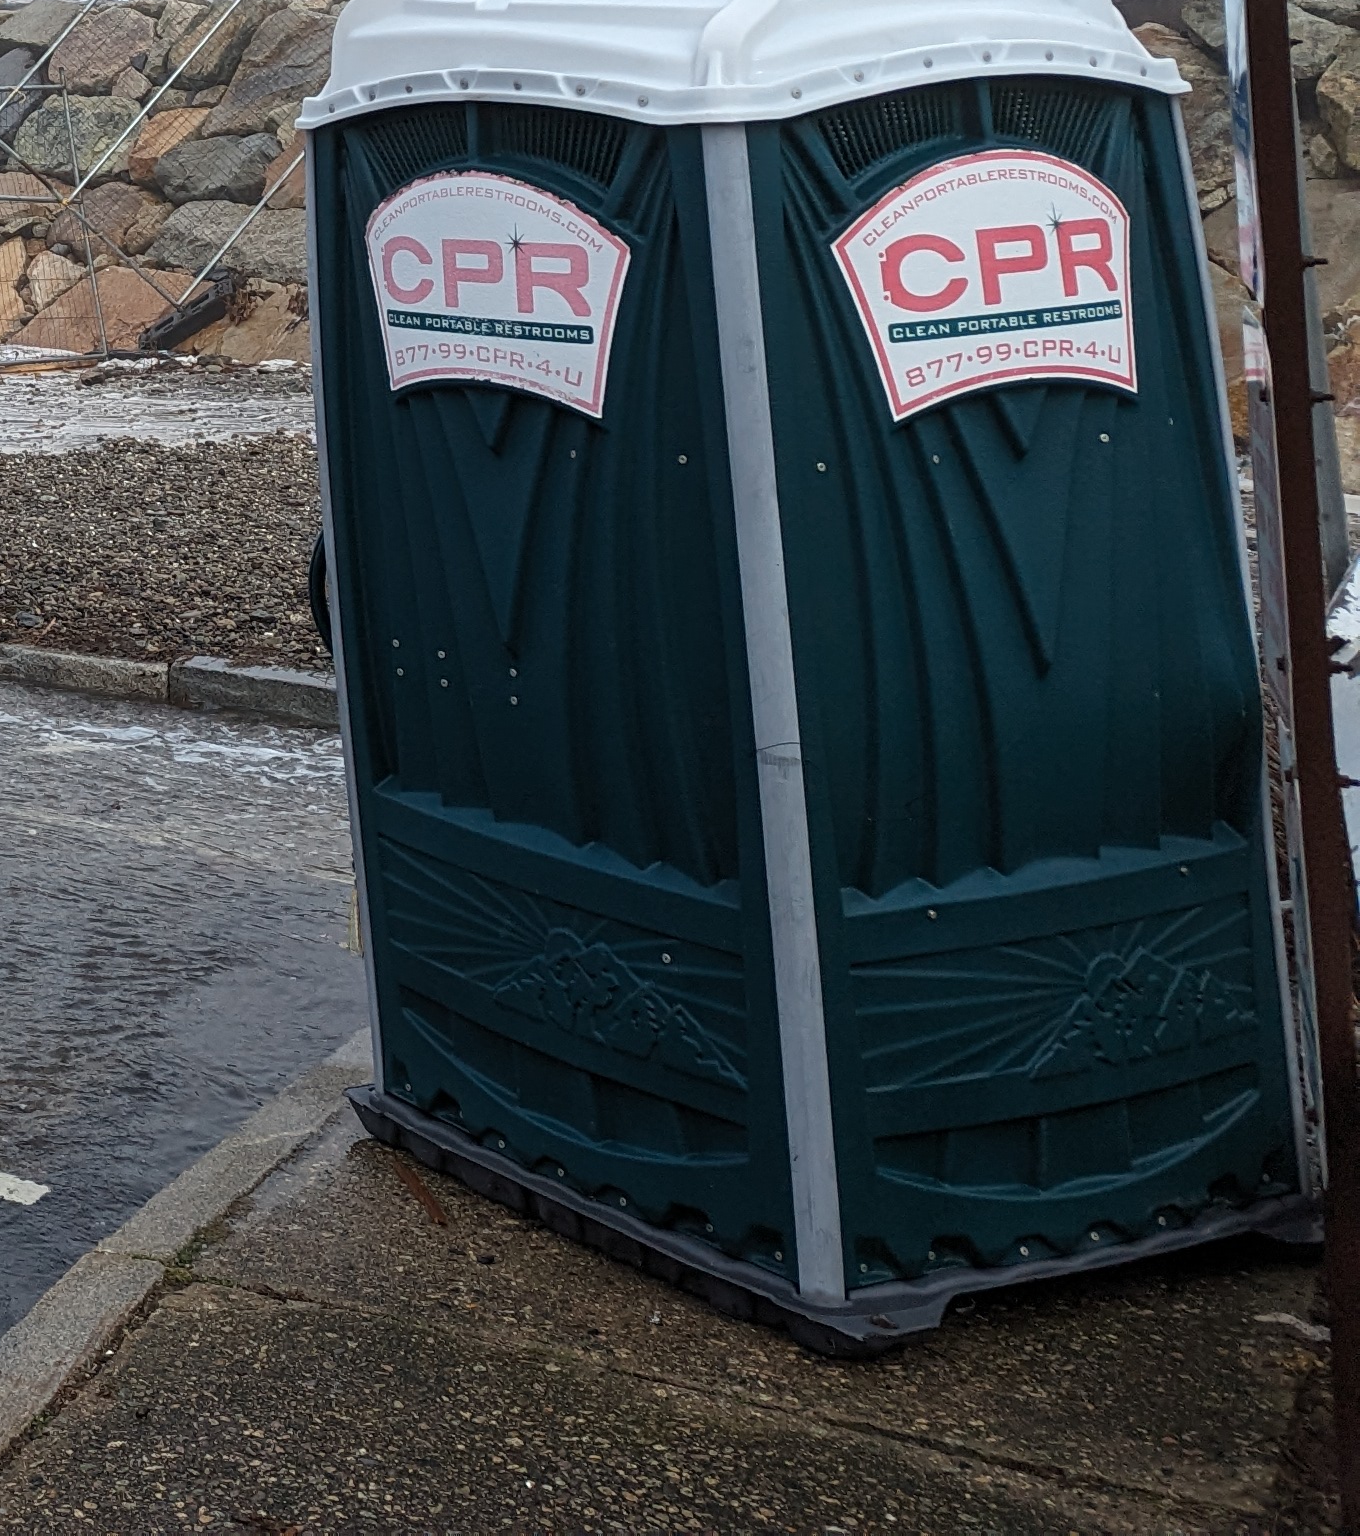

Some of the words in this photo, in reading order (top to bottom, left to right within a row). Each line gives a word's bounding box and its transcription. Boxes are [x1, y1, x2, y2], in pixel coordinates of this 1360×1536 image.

[373, 186, 603, 254] CLEANPORTABLERESTROOMS.COM
[863, 168, 1119, 248] CLEANPORTABLERESTROOMS.COM
[381, 235, 592, 317] CPR
[879, 217, 1120, 313] CPR
[387, 313, 421, 327] CLEAN
[425, 317, 492, 333] PORTABLE
[495, 322, 591, 341] RESTROOMS
[893, 322, 951, 340] CLEAN
[957, 314, 1038, 332] PORTABLE
[1042, 304, 1122, 323] RESTROOMS
